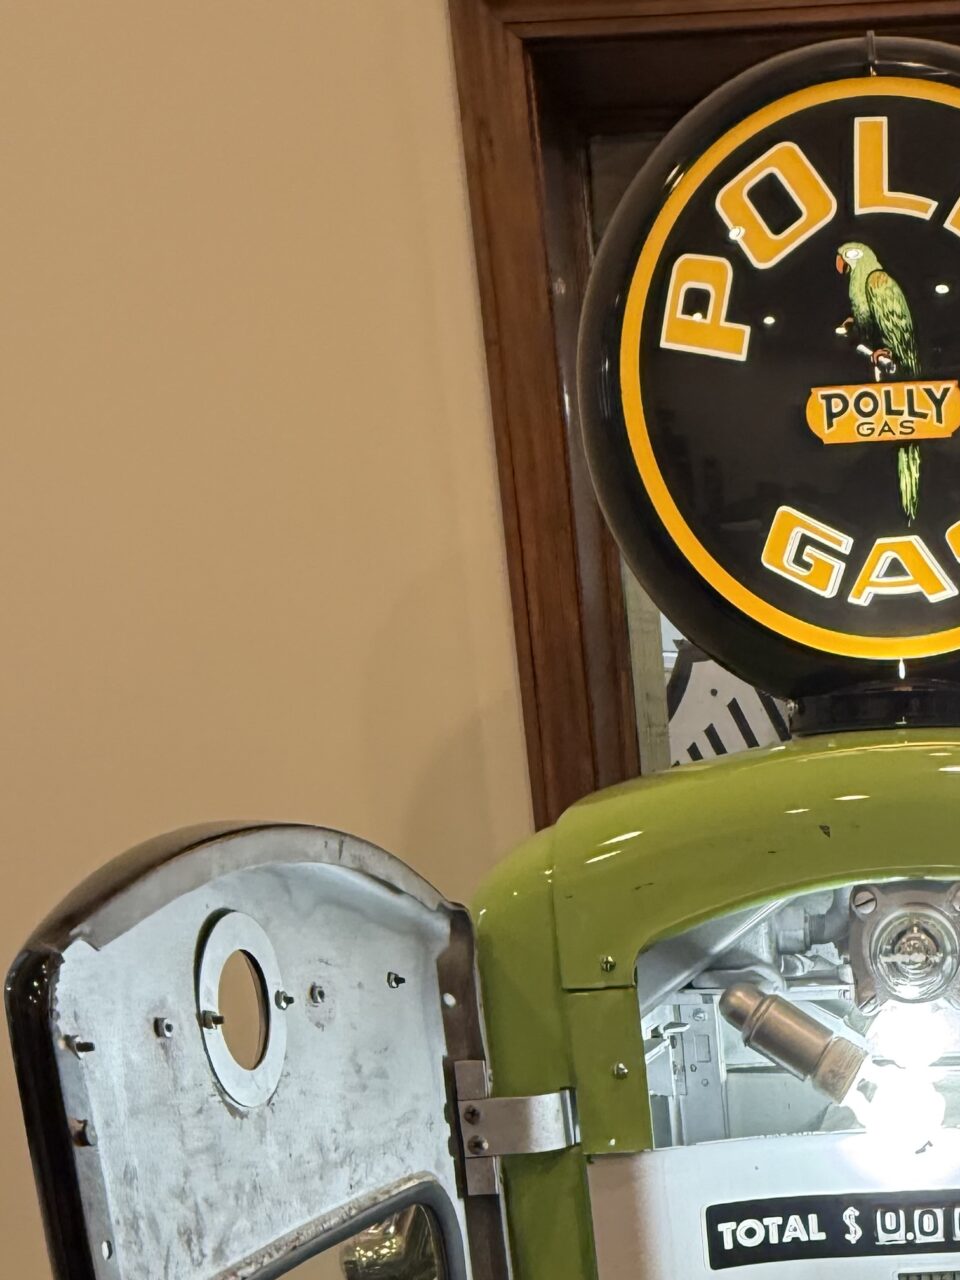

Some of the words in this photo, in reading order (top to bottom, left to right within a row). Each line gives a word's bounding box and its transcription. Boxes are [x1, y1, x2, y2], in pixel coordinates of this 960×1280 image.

[819, 386, 952, 431] POLLY
[856, 419, 916, 437] GAS
[717, 1213, 827, 1251] TOTAL
